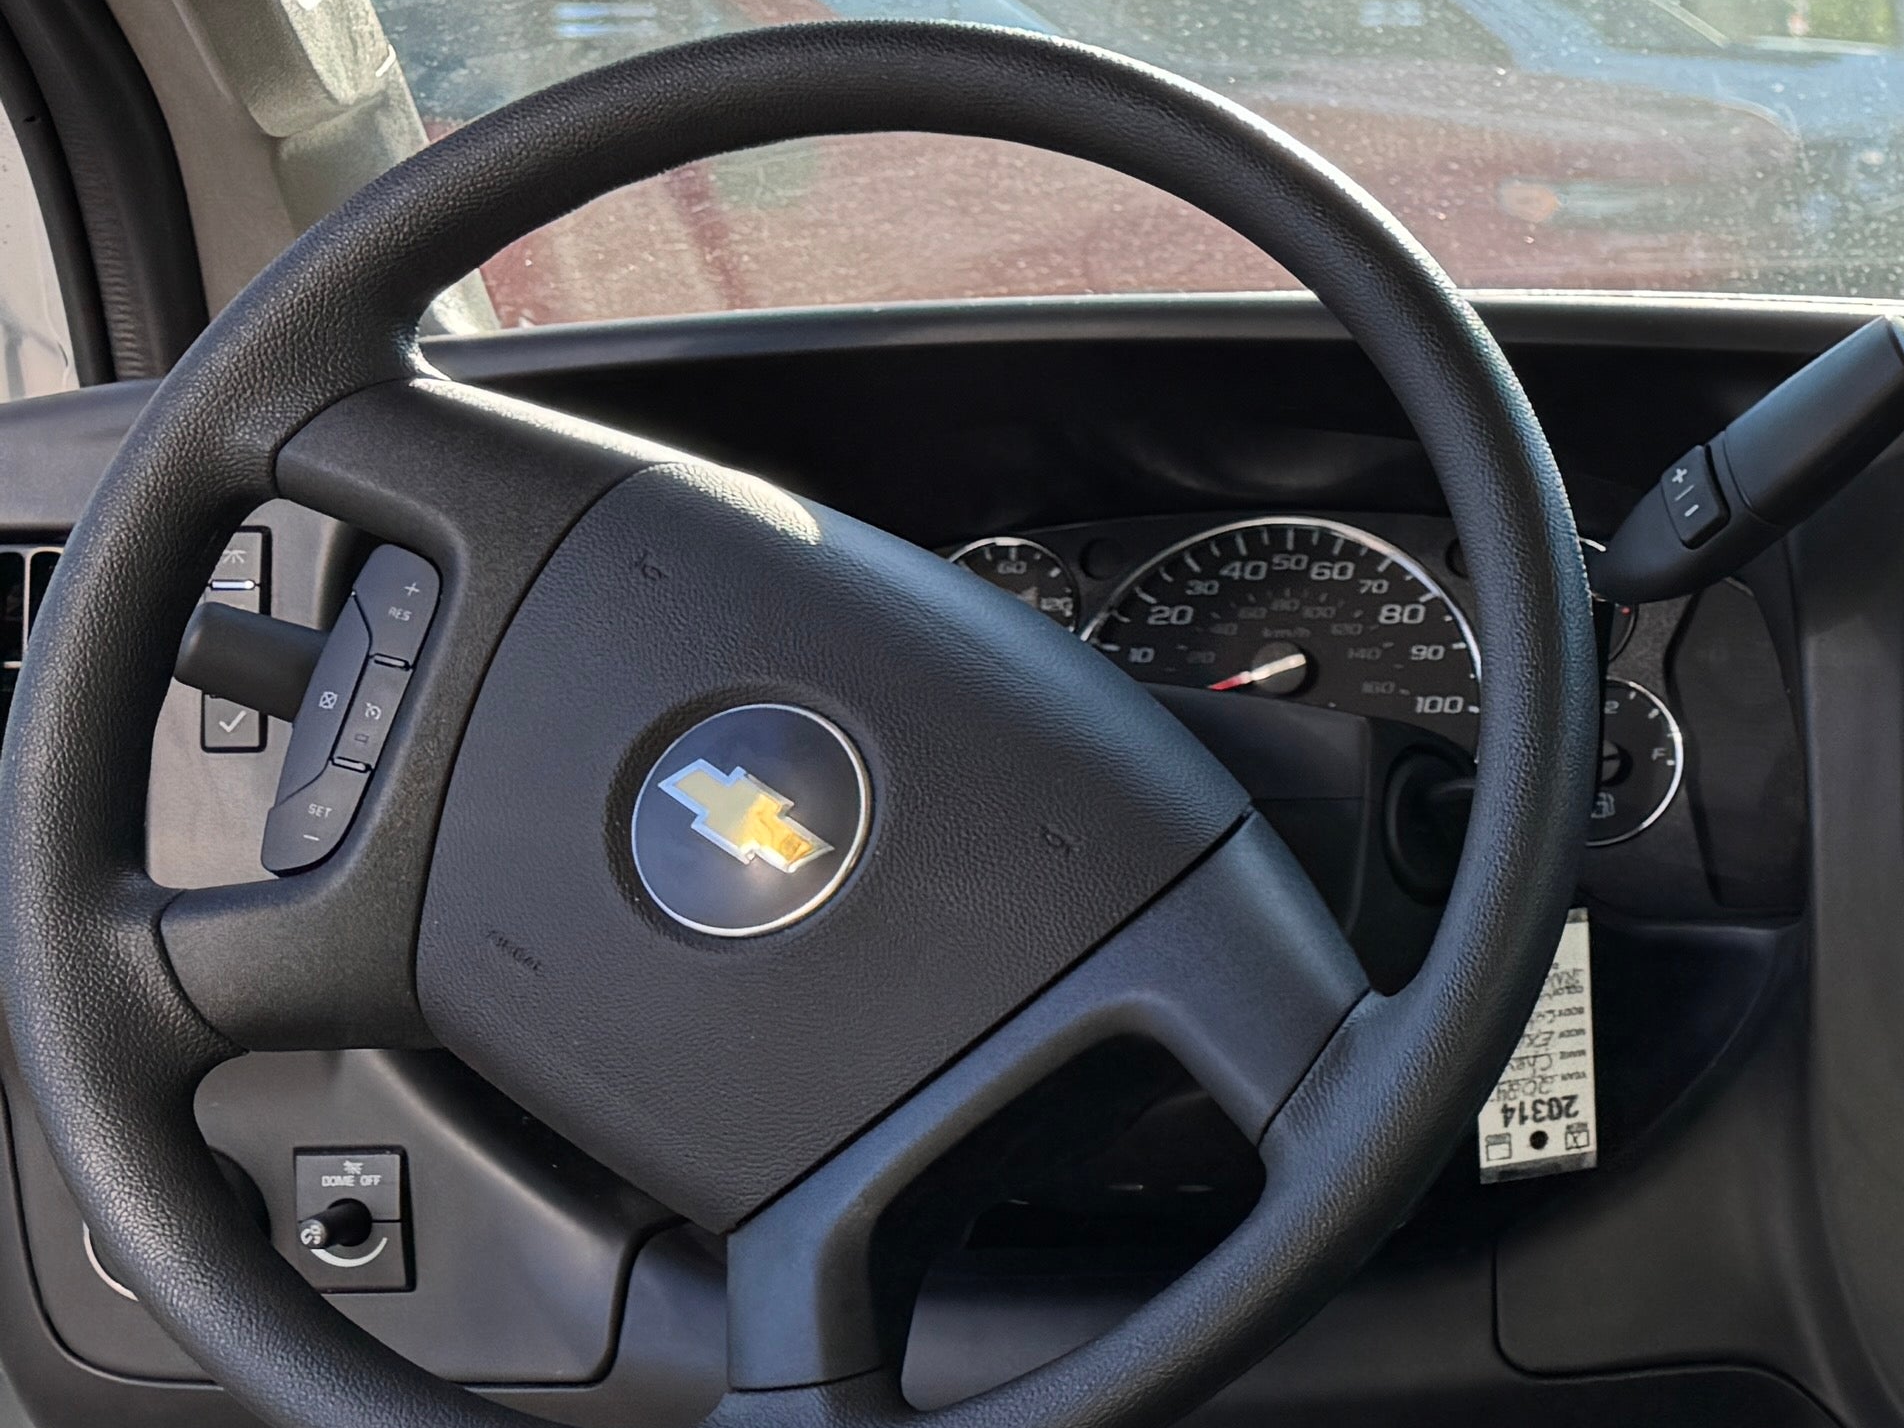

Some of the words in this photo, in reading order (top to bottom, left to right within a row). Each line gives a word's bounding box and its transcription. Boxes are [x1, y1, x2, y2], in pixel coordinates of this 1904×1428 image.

[1219, 560, 1268, 580] 40
[1272, 554, 1308, 570] 50
[1310, 561, 1355, 580] 60
[1185, 579, 1219, 596] 30
[1359, 579, 1389, 594] 70
[388, 606, 412, 622] RES
[1148, 605, 1194, 625] 20
[1378, 603, 1425, 624] 80
[1128, 647, 1155, 663] 10
[1410, 644, 1445, 660] 90
[1415, 696, 1463, 714] 100
[308, 803, 333, 818] SET
[1501, 1095, 1579, 1128] 20314
[322, 1175, 355, 1186] DOME
[361, 1175, 382, 1186] OFF
